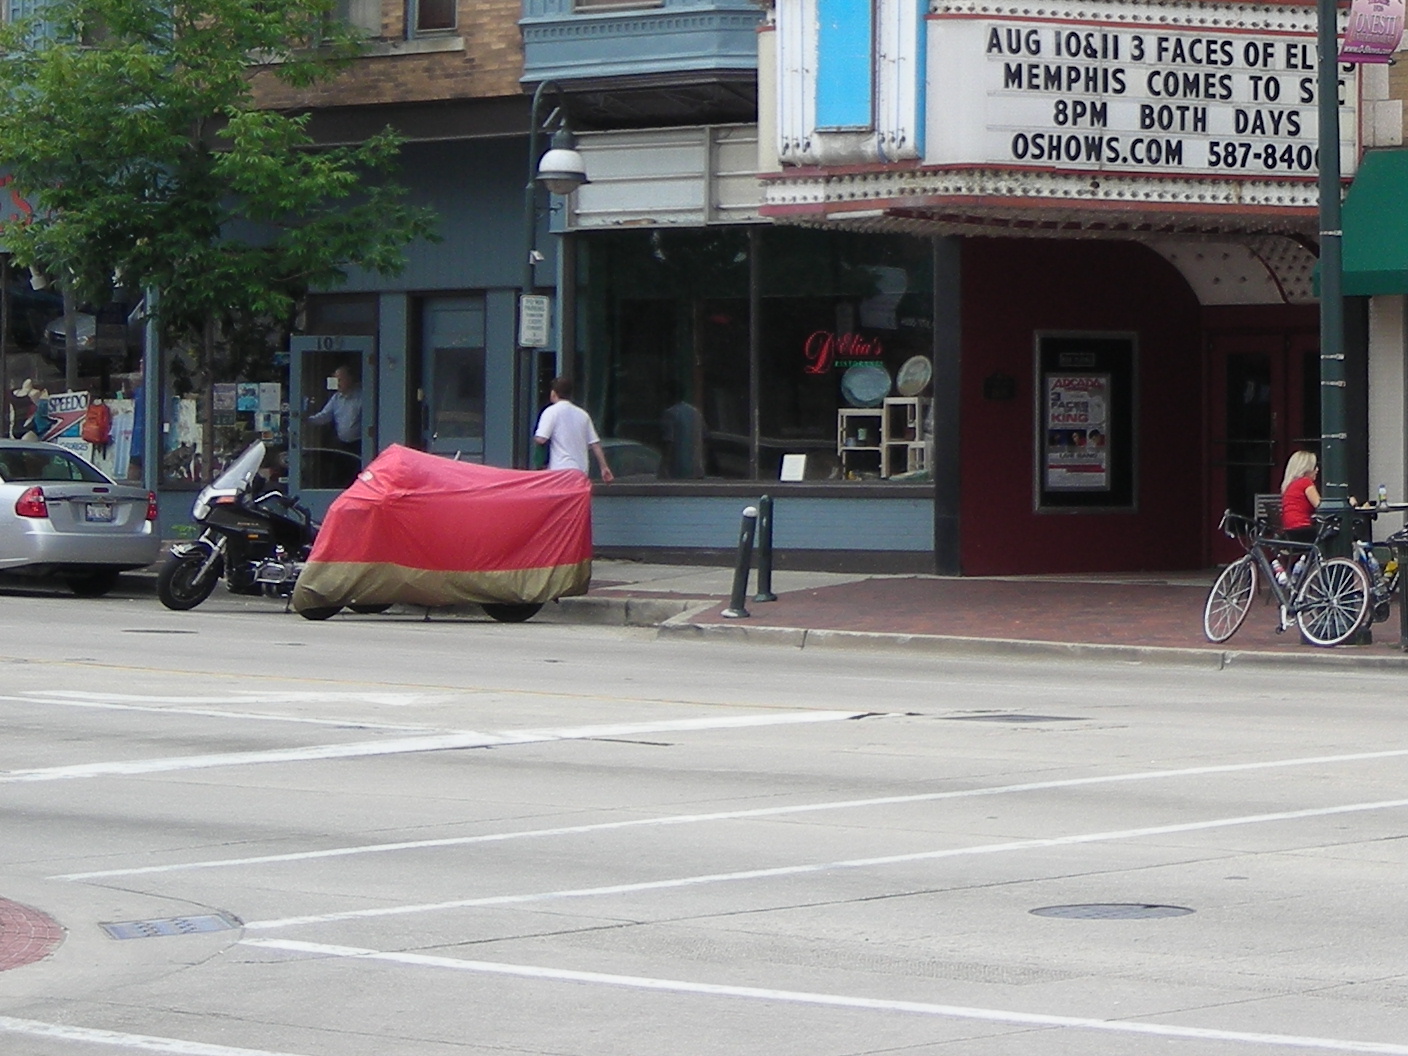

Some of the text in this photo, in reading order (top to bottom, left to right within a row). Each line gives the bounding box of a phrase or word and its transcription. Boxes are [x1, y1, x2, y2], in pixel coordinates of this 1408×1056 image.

[986, 27, 1041, 57] AUG
[1054, 30, 1120, 60] 10&11
[1130, 35, 1145, 62] 3
[1156, 37, 1234, 67] FACES
[1243, 41, 1275, 68] OF
[1003, 62, 1126, 94] MEMPHIS
[1146, 70, 1233, 101] COMES
[1249, 75, 1281, 102] TO
[1053, 99, 1301, 137] 8PM BOTH DAYS
[1011, 132, 1320, 171] OSHOWS.COM 587-840
[49, 393, 88, 412] SPEEDO
[1050, 413, 1089, 423] KING
